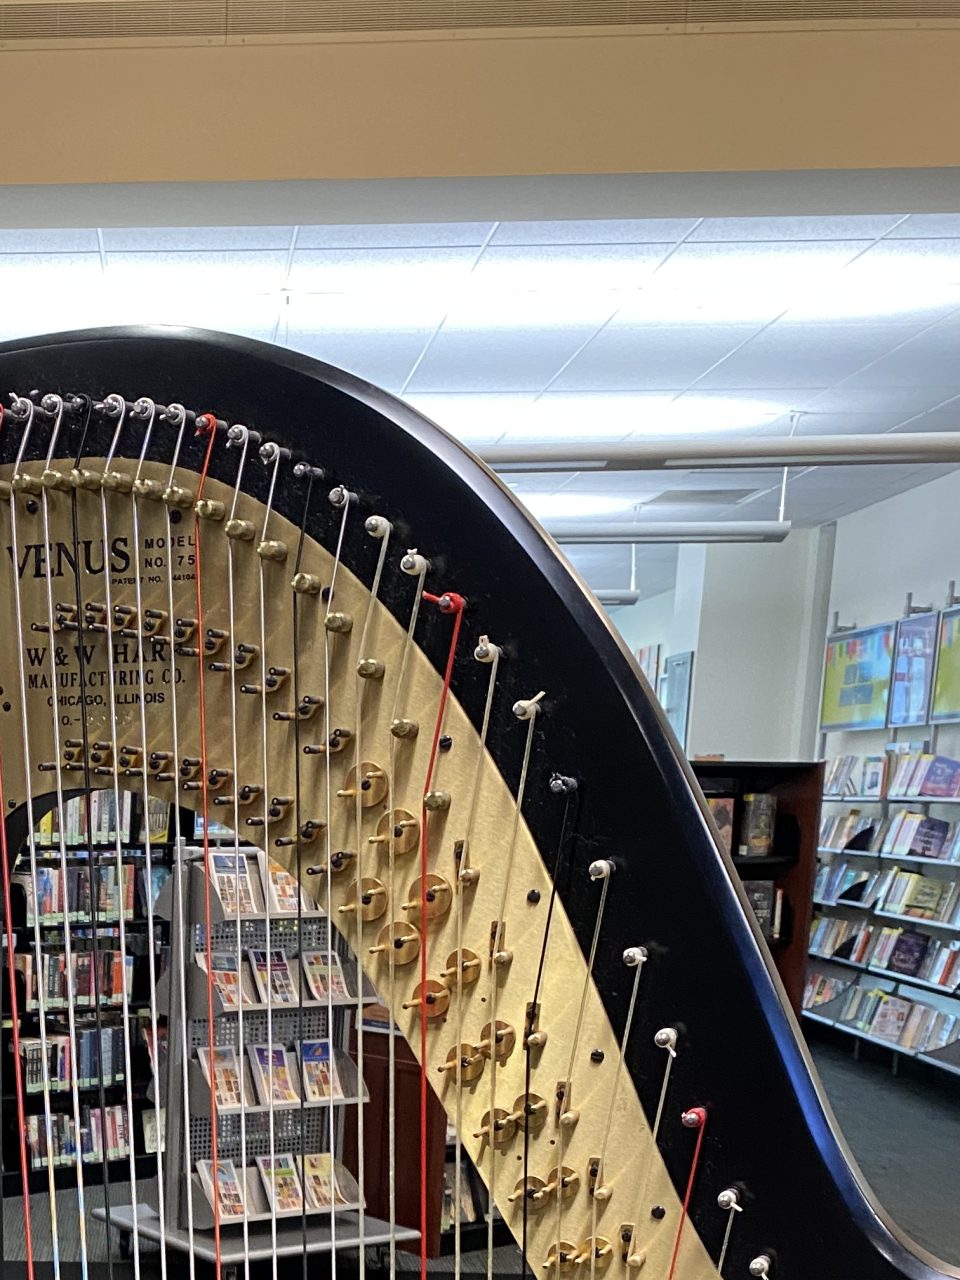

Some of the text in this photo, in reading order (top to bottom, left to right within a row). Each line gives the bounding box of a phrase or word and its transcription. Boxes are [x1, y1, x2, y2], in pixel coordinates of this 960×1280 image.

[144, 536, 196, 549] MODEL
[6, 537, 130, 580] VENUS
[144, 554, 196, 568] NO. 75
[26, 643, 178, 667] W & W HAR
[162, 668, 186, 684] CO.
